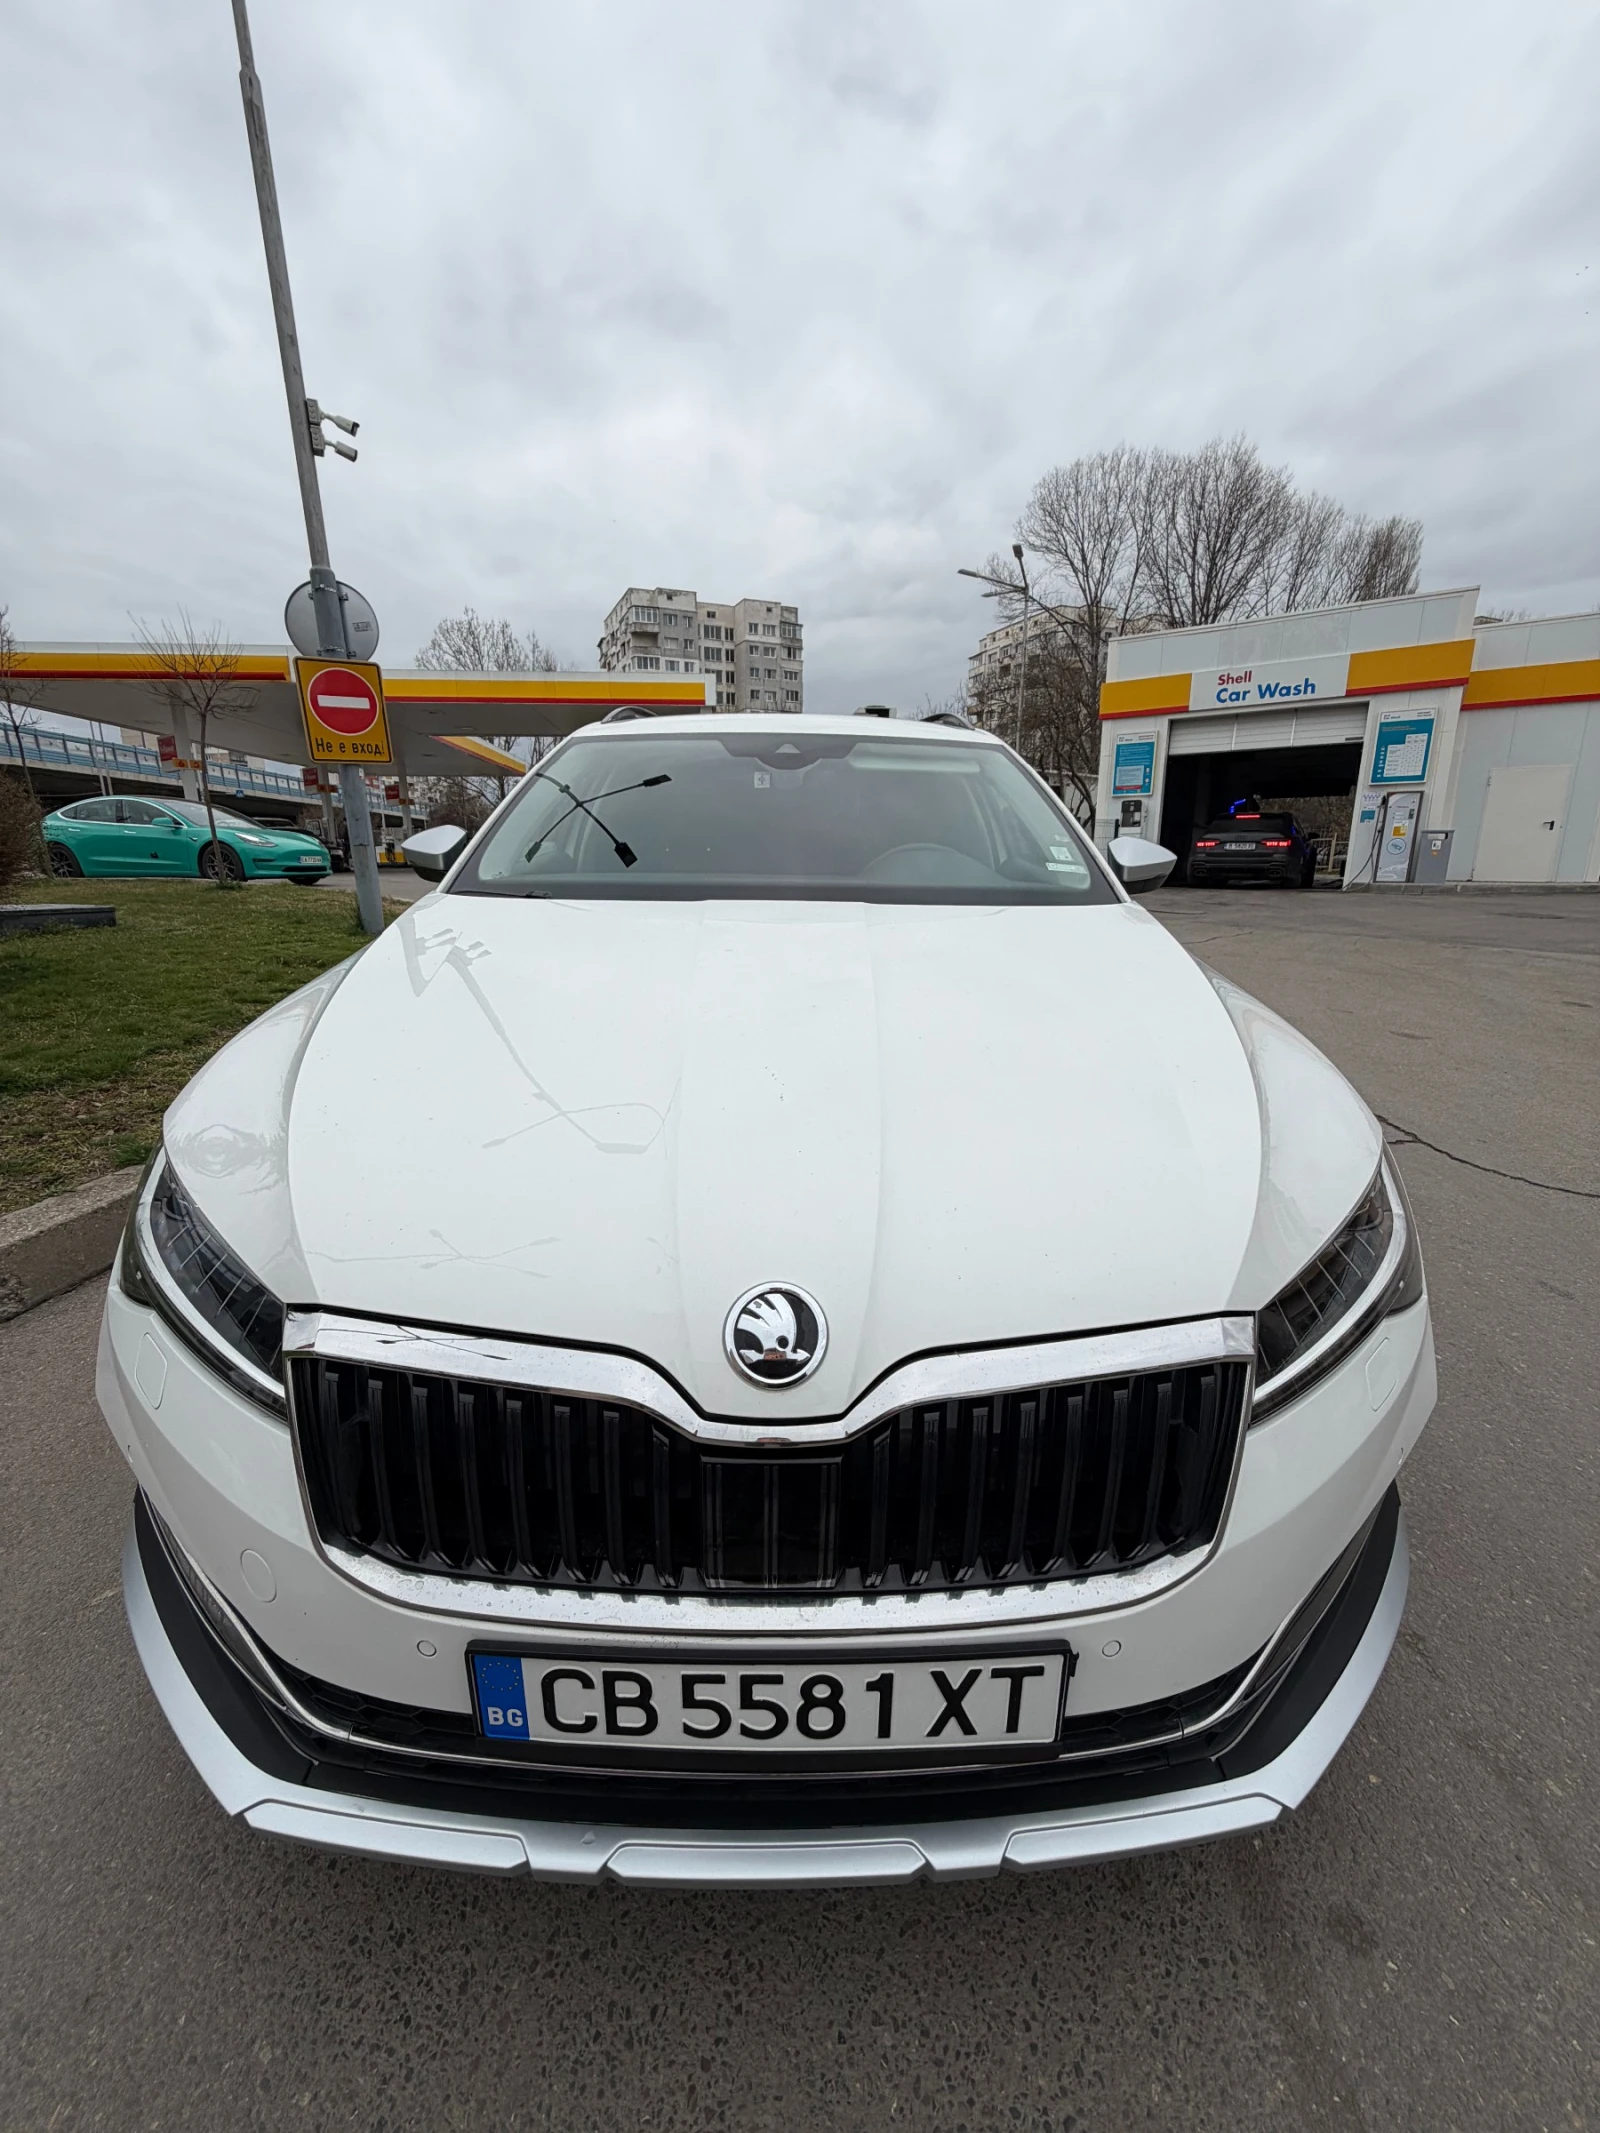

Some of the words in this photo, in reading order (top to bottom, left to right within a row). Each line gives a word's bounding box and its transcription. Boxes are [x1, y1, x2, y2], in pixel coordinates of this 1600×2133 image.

[1217, 670, 1253, 686] Shell
[1216, 687, 1251, 703] Car
[1257, 678, 1316, 699] Wash
[315, 737, 333, 753] Не
[339, 742, 346, 753] е
[351, 740, 385, 756] вход!
[541, 1668, 658, 1736] CB
[681, 1672, 894, 1740] 5581
[924, 1665, 1045, 1738] XT
[487, 1707, 523, 1727] BG
